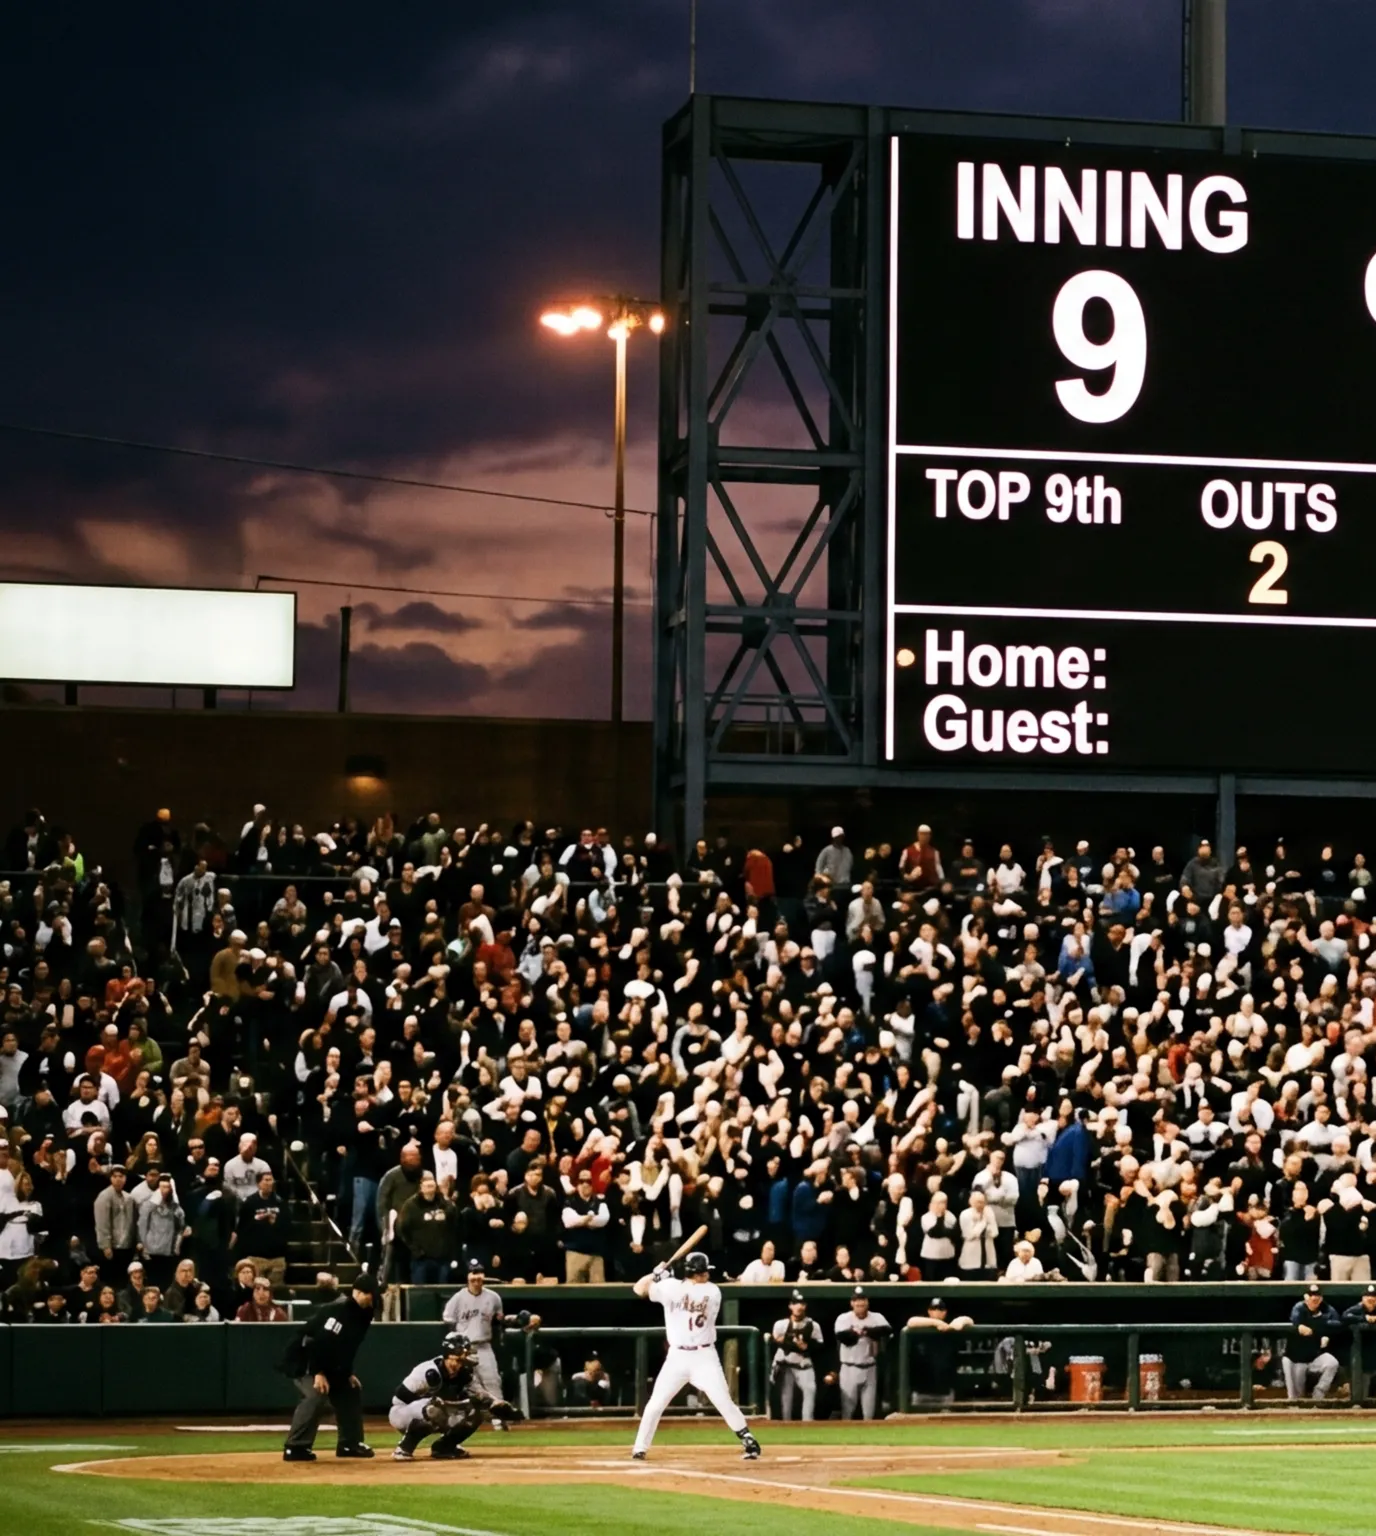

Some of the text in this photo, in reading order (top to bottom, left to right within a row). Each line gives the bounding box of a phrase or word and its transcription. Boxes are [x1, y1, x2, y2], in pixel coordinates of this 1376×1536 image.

[957, 161, 1249, 254] INNING
[1052, 269, 1148, 424] 9
[925, 468, 1122, 525] TOP 9th
[1200, 478, 1338, 533] OUTS
[1248, 540, 1289, 605] 2
[925, 628, 1107, 690] Home:
[923, 693, 1109, 755] Guest:
